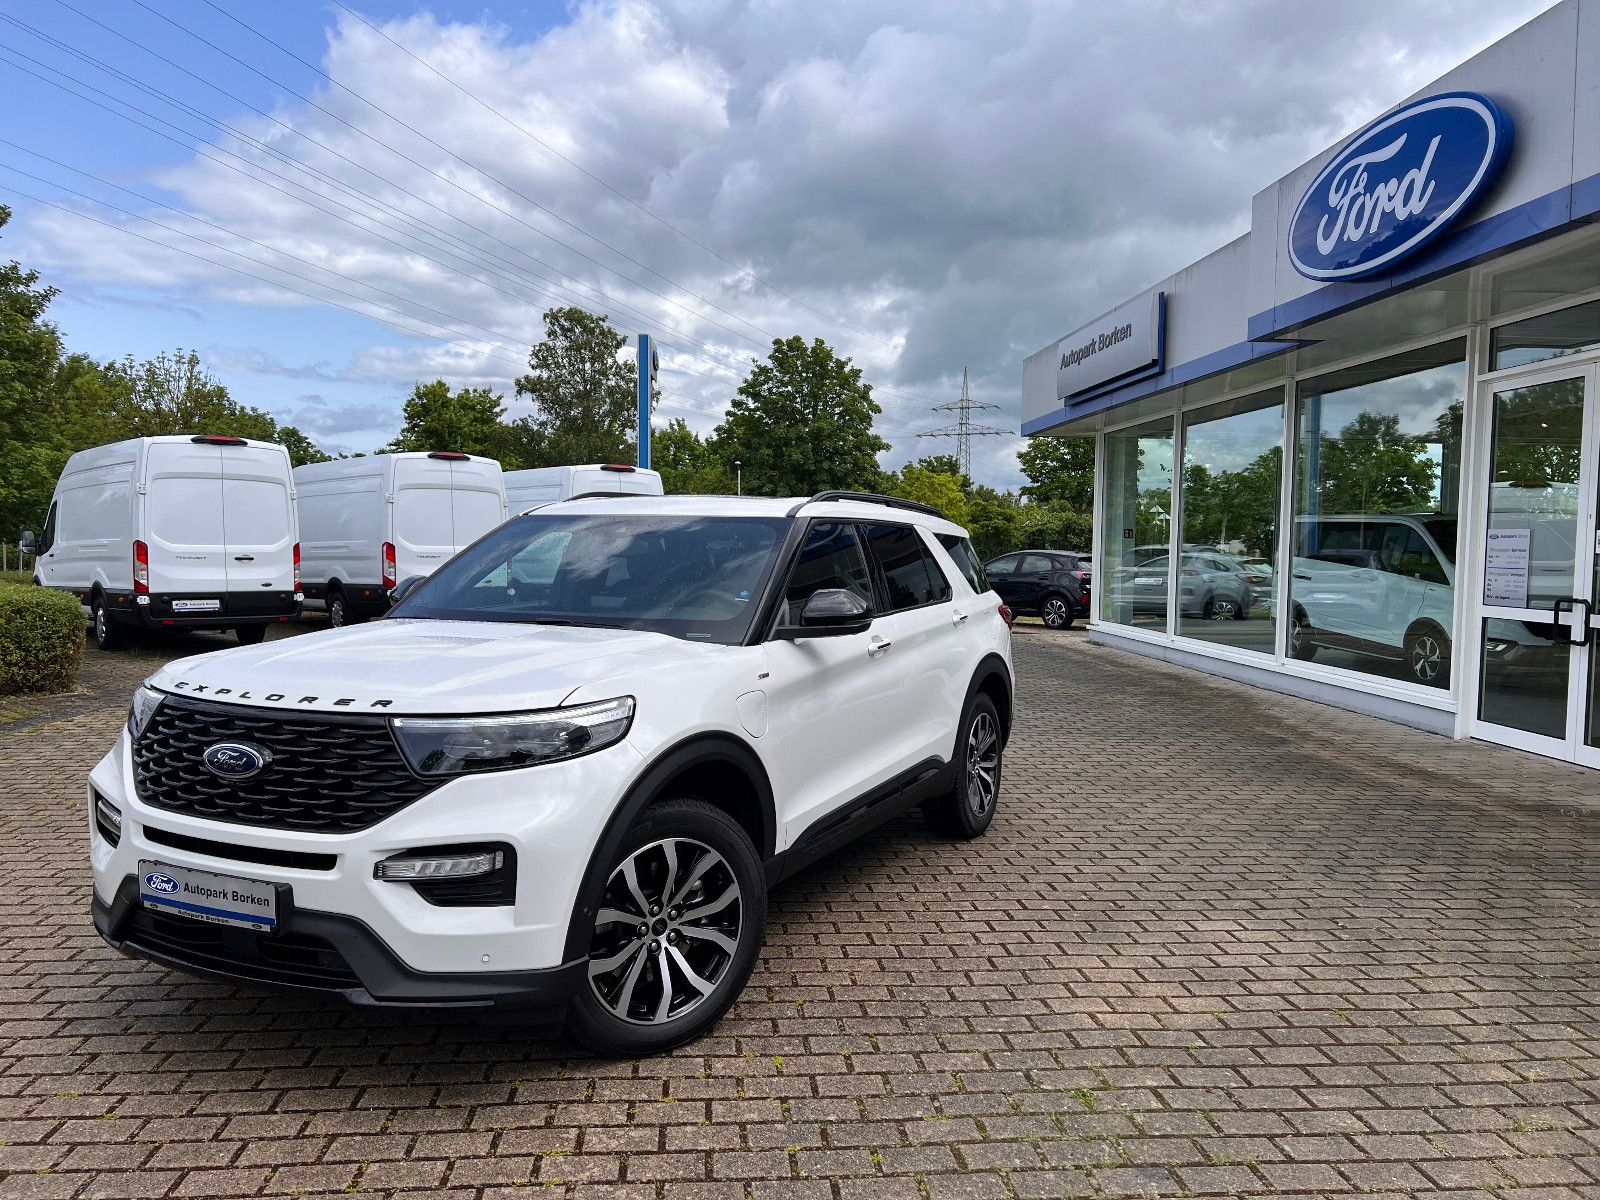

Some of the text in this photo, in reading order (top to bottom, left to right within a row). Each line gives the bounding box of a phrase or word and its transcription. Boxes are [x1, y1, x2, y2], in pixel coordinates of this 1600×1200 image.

[1316, 132, 1442, 256] Ford
[1060, 322, 1132, 370] Autopark Borken
[174, 681, 394, 708] EXPLORER
[213, 750, 246, 770] Ford
[150, 874, 174, 892] Ford
[183, 881, 270, 907] Autopark Borken
[177, 909, 230, 924] Autopark Borken
